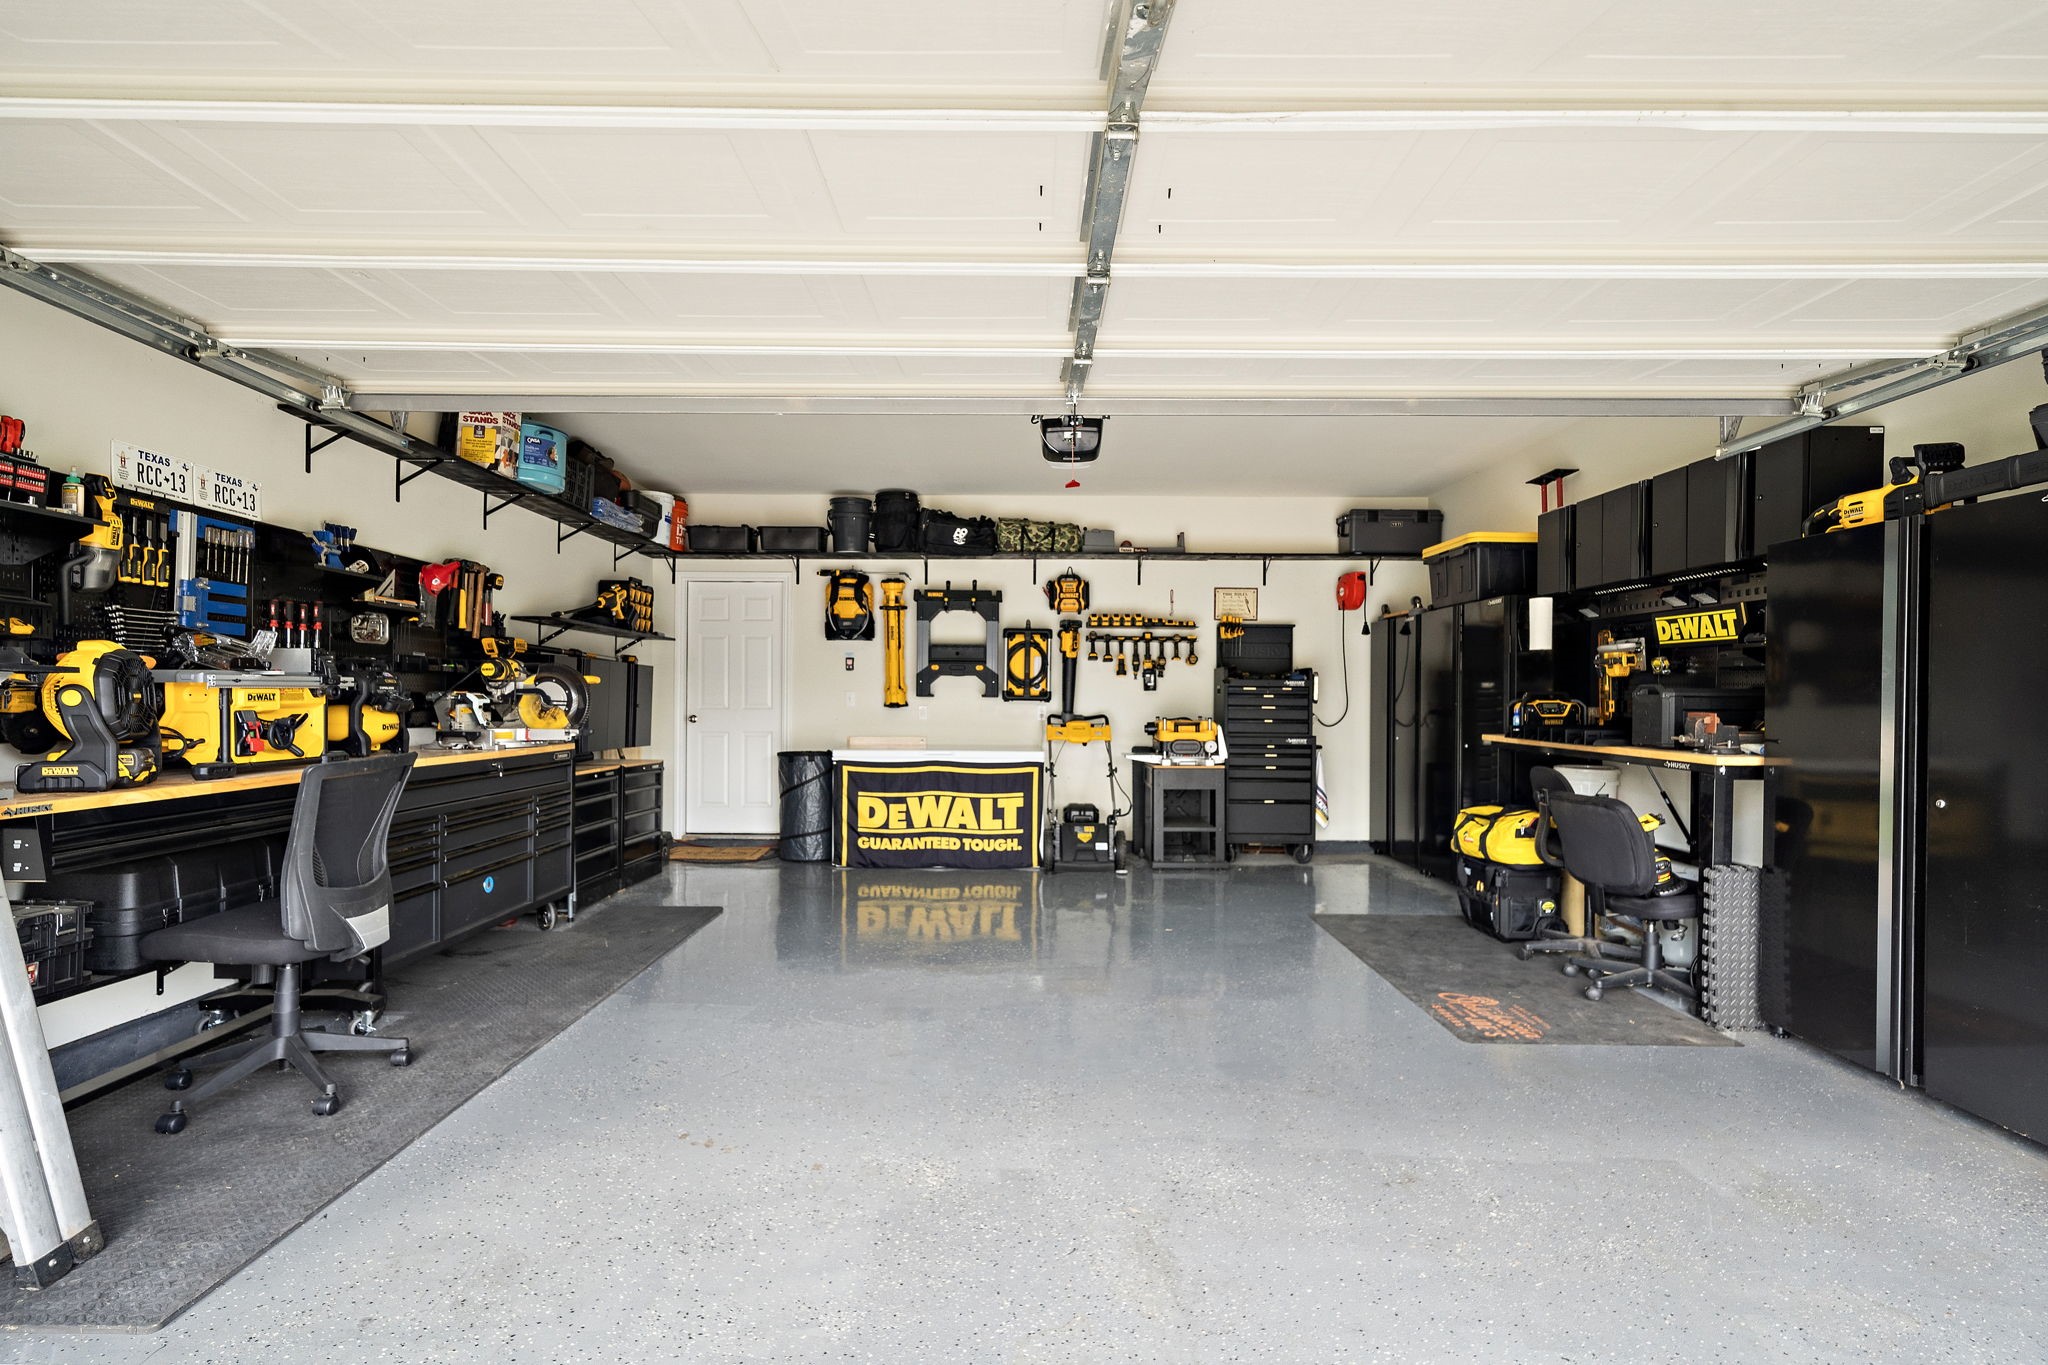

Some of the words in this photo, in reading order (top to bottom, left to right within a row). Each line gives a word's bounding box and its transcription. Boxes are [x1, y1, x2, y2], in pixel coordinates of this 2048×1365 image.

[463, 415, 498, 425] STANDS
[138, 450, 170, 467] TEXAS
[137, 462, 162, 488] RCC
[170, 472, 186, 494] 13
[215, 473, 242, 487] TEXAS
[214, 484, 236, 507] RCC
[242, 492, 256, 512] 13
[1670, 761, 1690, 770] HUSKY
[857, 836, 962, 851] GUARANTEED
[962, 837, 1023, 852] TOUGH.
